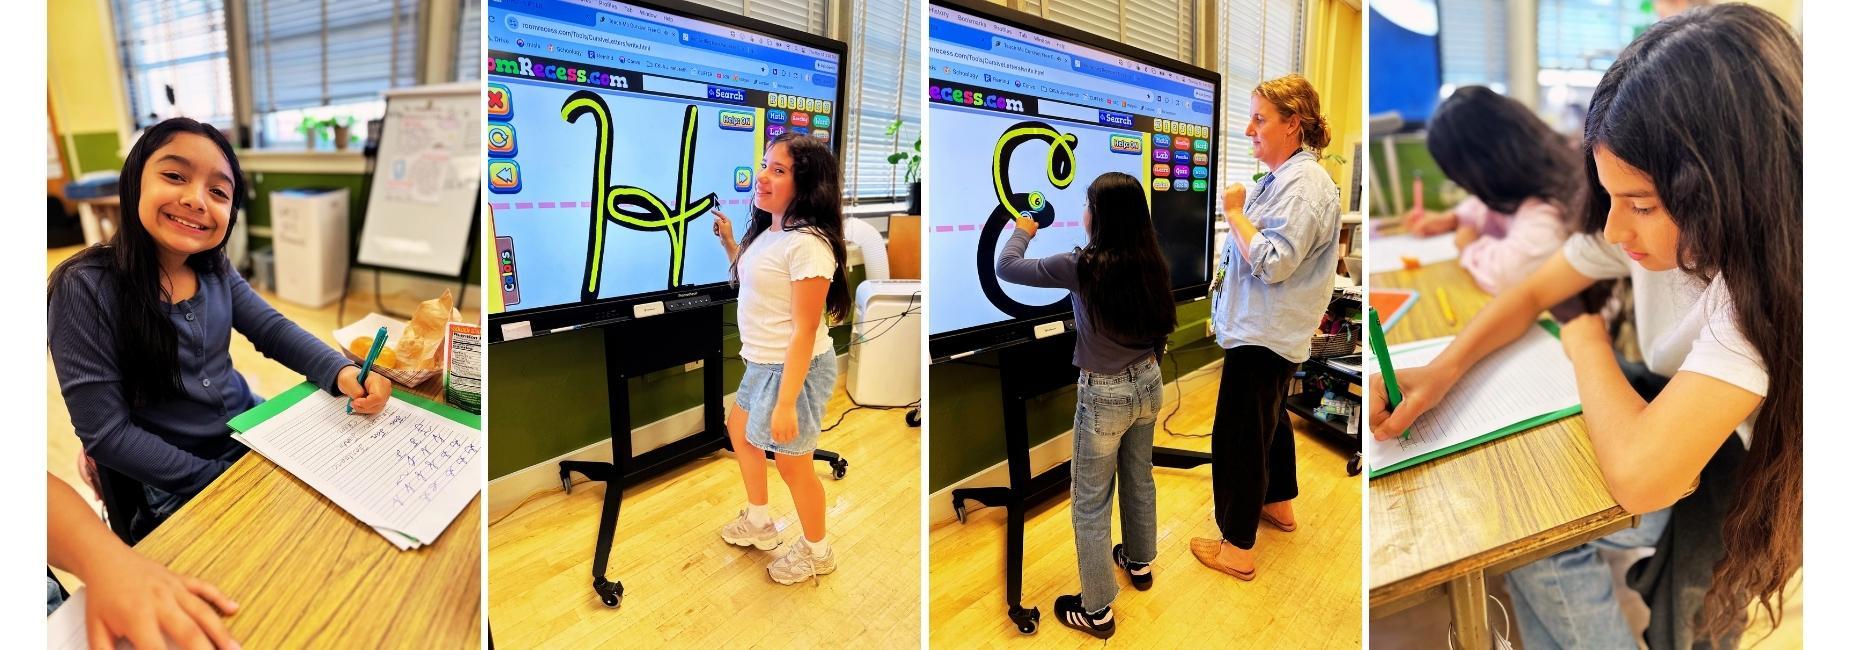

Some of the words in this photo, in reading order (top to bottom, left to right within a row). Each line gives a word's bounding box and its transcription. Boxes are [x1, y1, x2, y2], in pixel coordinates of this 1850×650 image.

[957, 15, 987, 28] Bookmarks
[715, 88, 744, 101] Search
[770, 112, 785, 121] Math
[1106, 111, 1132, 125] Search
[769, 127, 784, 136] Lab
[1114, 139, 1129, 149] Help:
[1156, 151, 1169, 159] Lab
[1175, 167, 1188, 175] Quiz
[501, 250, 515, 292] Colors
